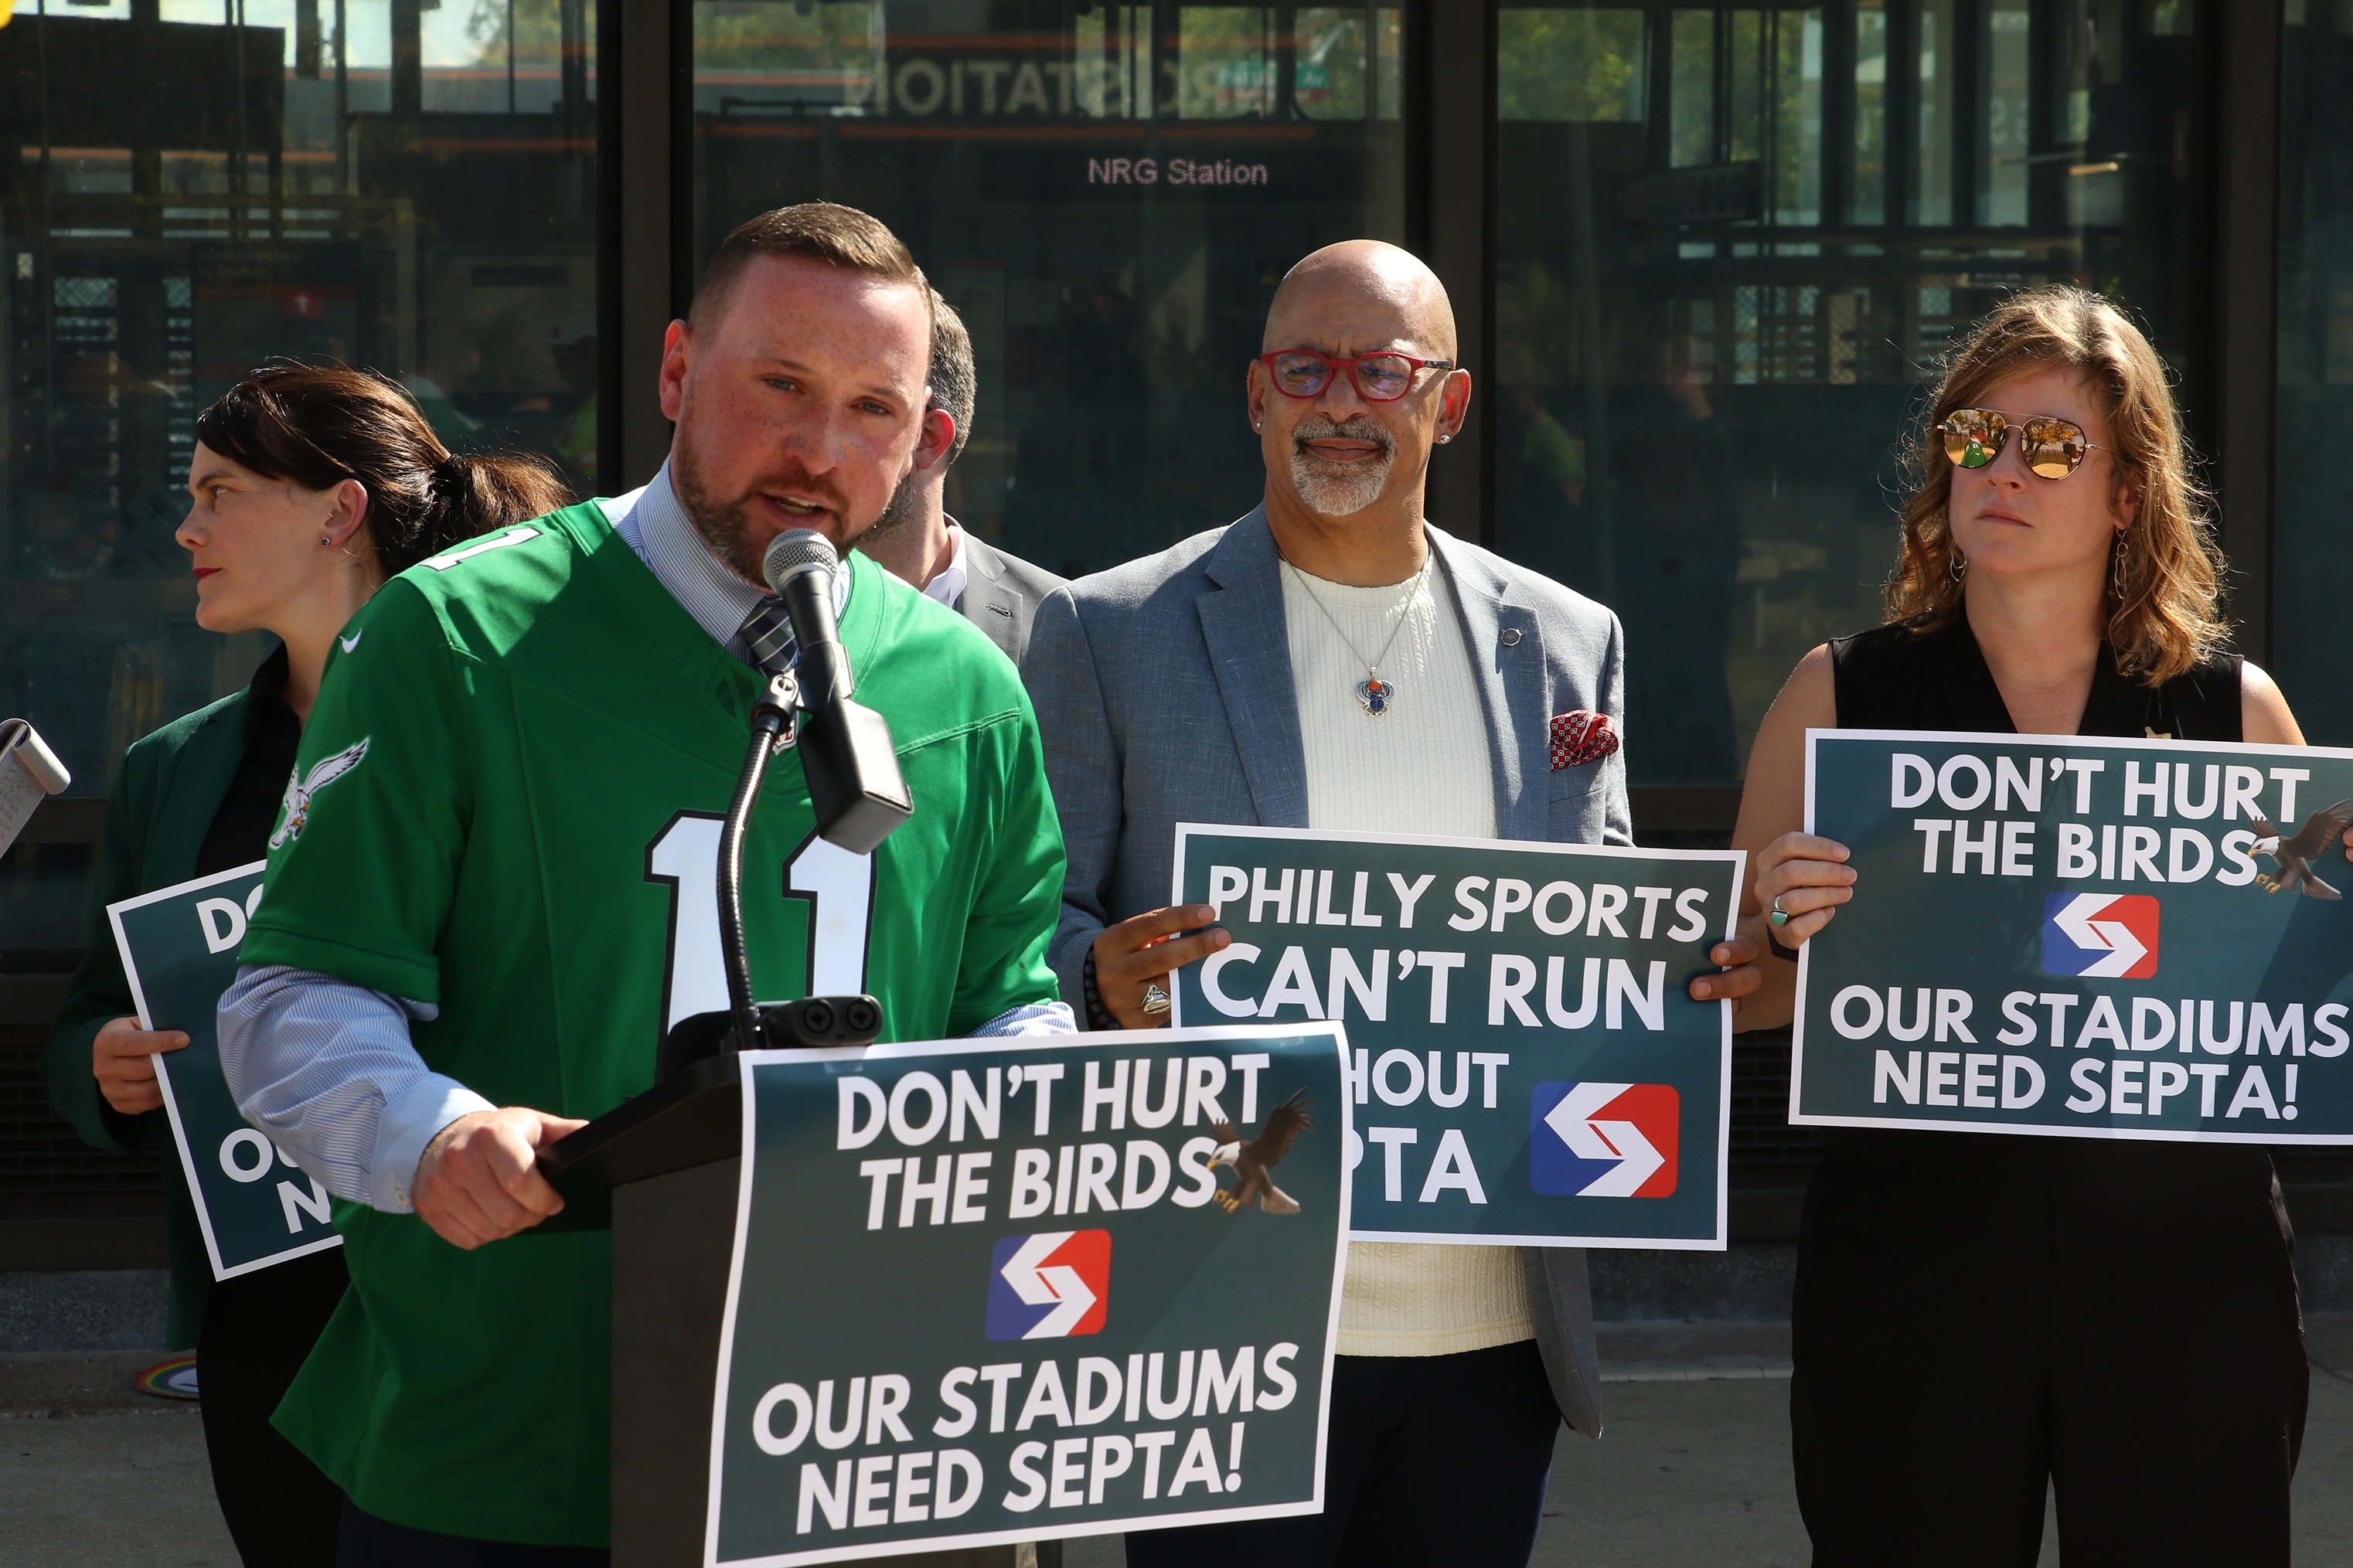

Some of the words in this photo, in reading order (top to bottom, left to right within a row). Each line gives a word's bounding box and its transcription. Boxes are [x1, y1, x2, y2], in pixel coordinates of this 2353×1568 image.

[1088, 157, 1158, 185] NRG
[1166, 157, 1268, 185] Station
[1892, 753, 2104, 814] DON'T
[2124, 761, 2310, 822] HURT
[1914, 819, 2035, 876] THE
[2057, 823, 2258, 886] BIRDS
[644, 808, 877, 1040] 11
[1209, 866, 1436, 928] PHILLY
[1448, 876, 1708, 942] SPORTS
[1200, 943, 1466, 1023] CAN'T
[1488, 954, 1667, 1030] RUN
[1830, 985, 1978, 1043] OUR
[1996, 991, 2349, 1057] STADIUMS
[837, 1063, 1064, 1150] DON'T
[1082, 1053, 1269, 1132] HURT
[1874, 1050, 2045, 1109] NEED
[2065, 1058, 2298, 1120] SEPTA!
[860, 1151, 992, 1230] THE
[1009, 1137, 1219, 1219] BIRDS
[1352, 1127, 1487, 1203] TA
[753, 1374, 914, 1455] OUR
[932, 1342, 1299, 1438] STADIUMS
[797, 1449, 983, 1534] NEED
[1002, 1422, 1245, 1512] SEPTA!
